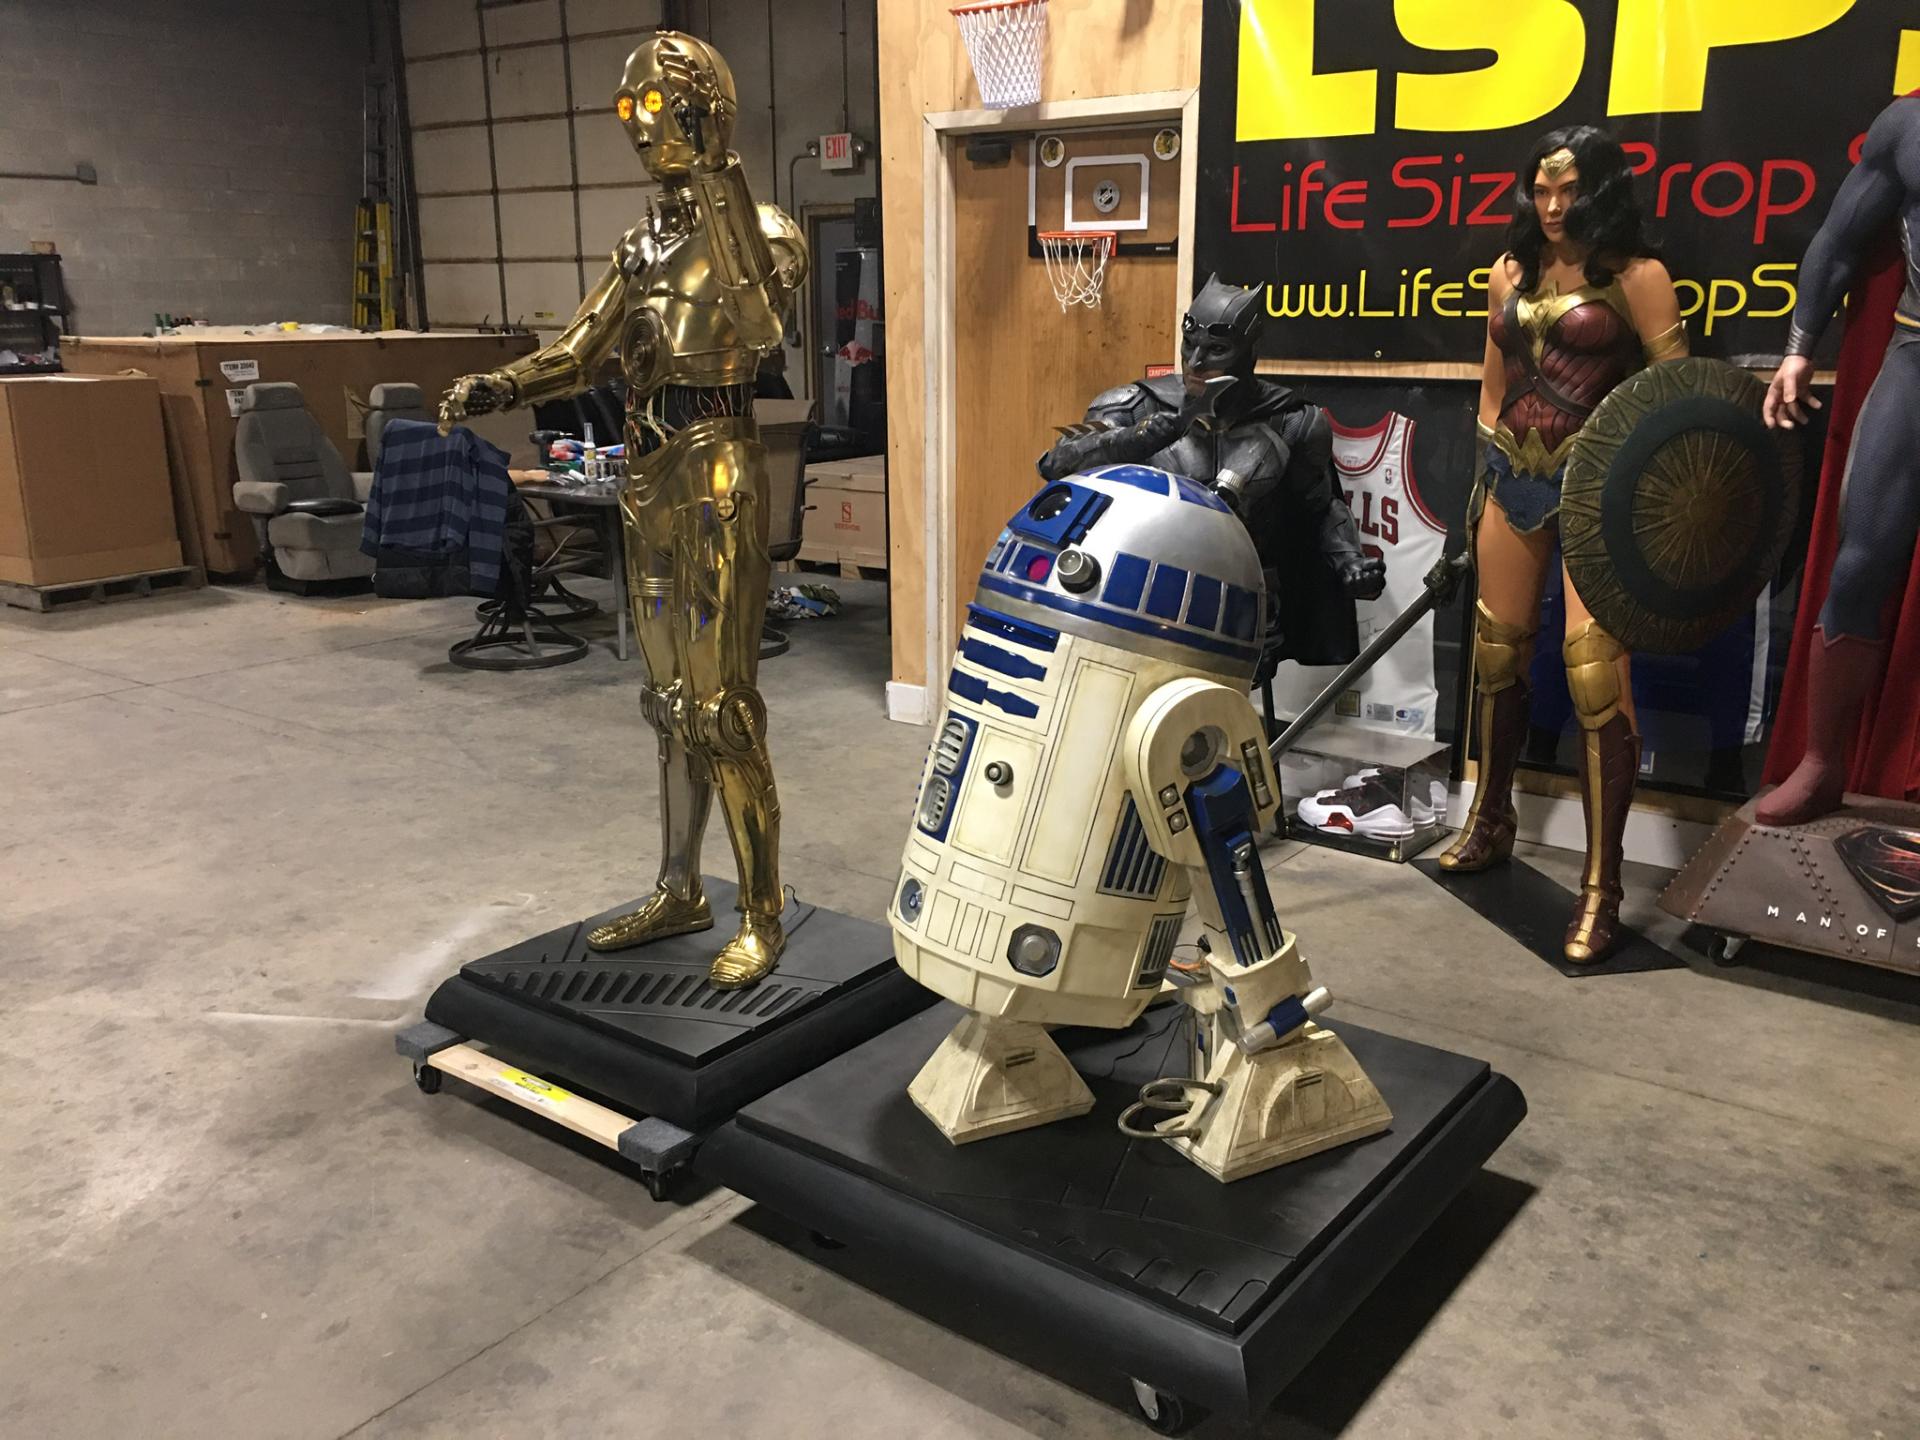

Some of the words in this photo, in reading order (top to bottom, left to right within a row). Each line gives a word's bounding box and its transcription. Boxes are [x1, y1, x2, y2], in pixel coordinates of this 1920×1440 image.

[826, 135, 848, 159] EXIT
[1231, 160, 1368, 232] Life
[1387, 153, 1517, 228] Siz
[1767, 905, 1832, 928] MAN
[1856, 924, 1887, 940] OF
